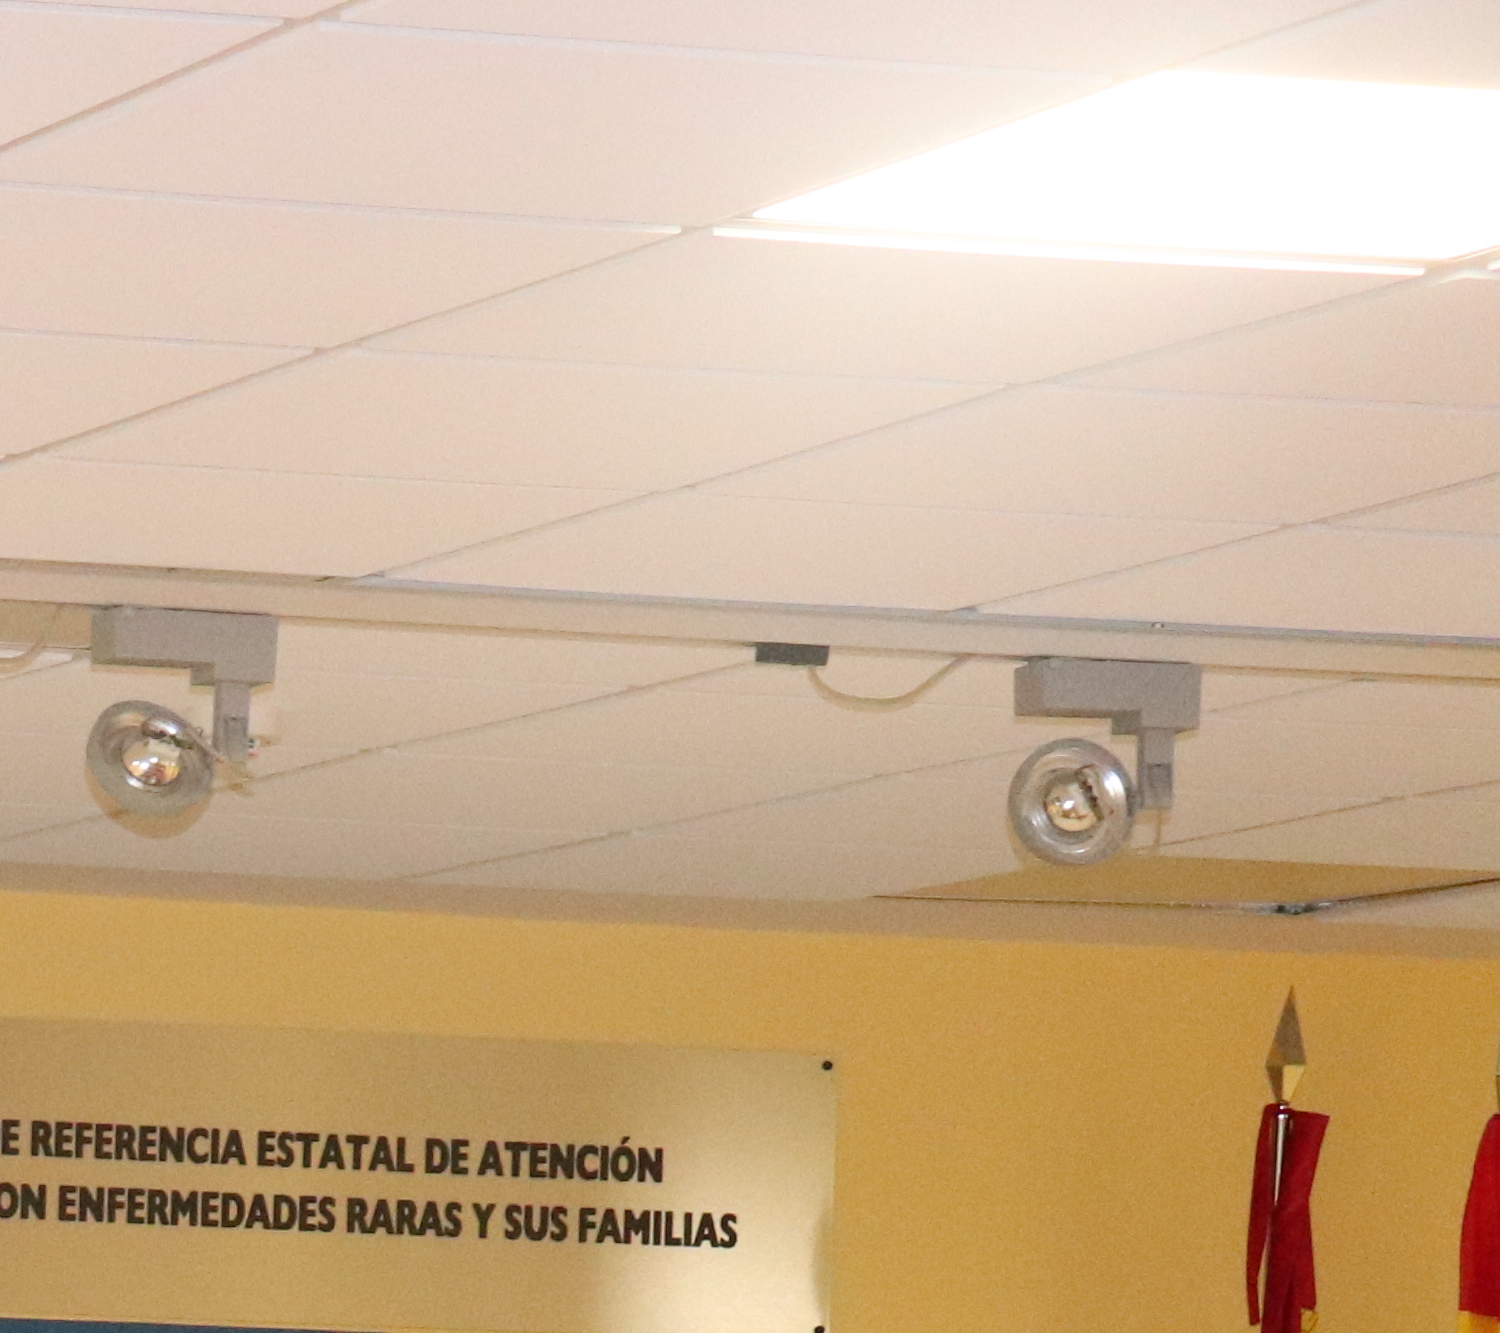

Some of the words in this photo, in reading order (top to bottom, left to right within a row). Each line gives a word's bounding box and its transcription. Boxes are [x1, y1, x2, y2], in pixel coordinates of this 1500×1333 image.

[31, 1119, 246, 1165] REFERENCIA
[258, 1128, 414, 1172] ESTATAL
[425, 1137, 468, 1173] DE
[479, 1136, 664, 1181] ATENCIÓN
[57, 1184, 335, 1232] ENFERMEDADES
[346, 1196, 462, 1237] RARAS
[473, 1202, 498, 1239] Y
[504, 1203, 569, 1242] SUS
[578, 1206, 738, 1248] FAMILIAS
